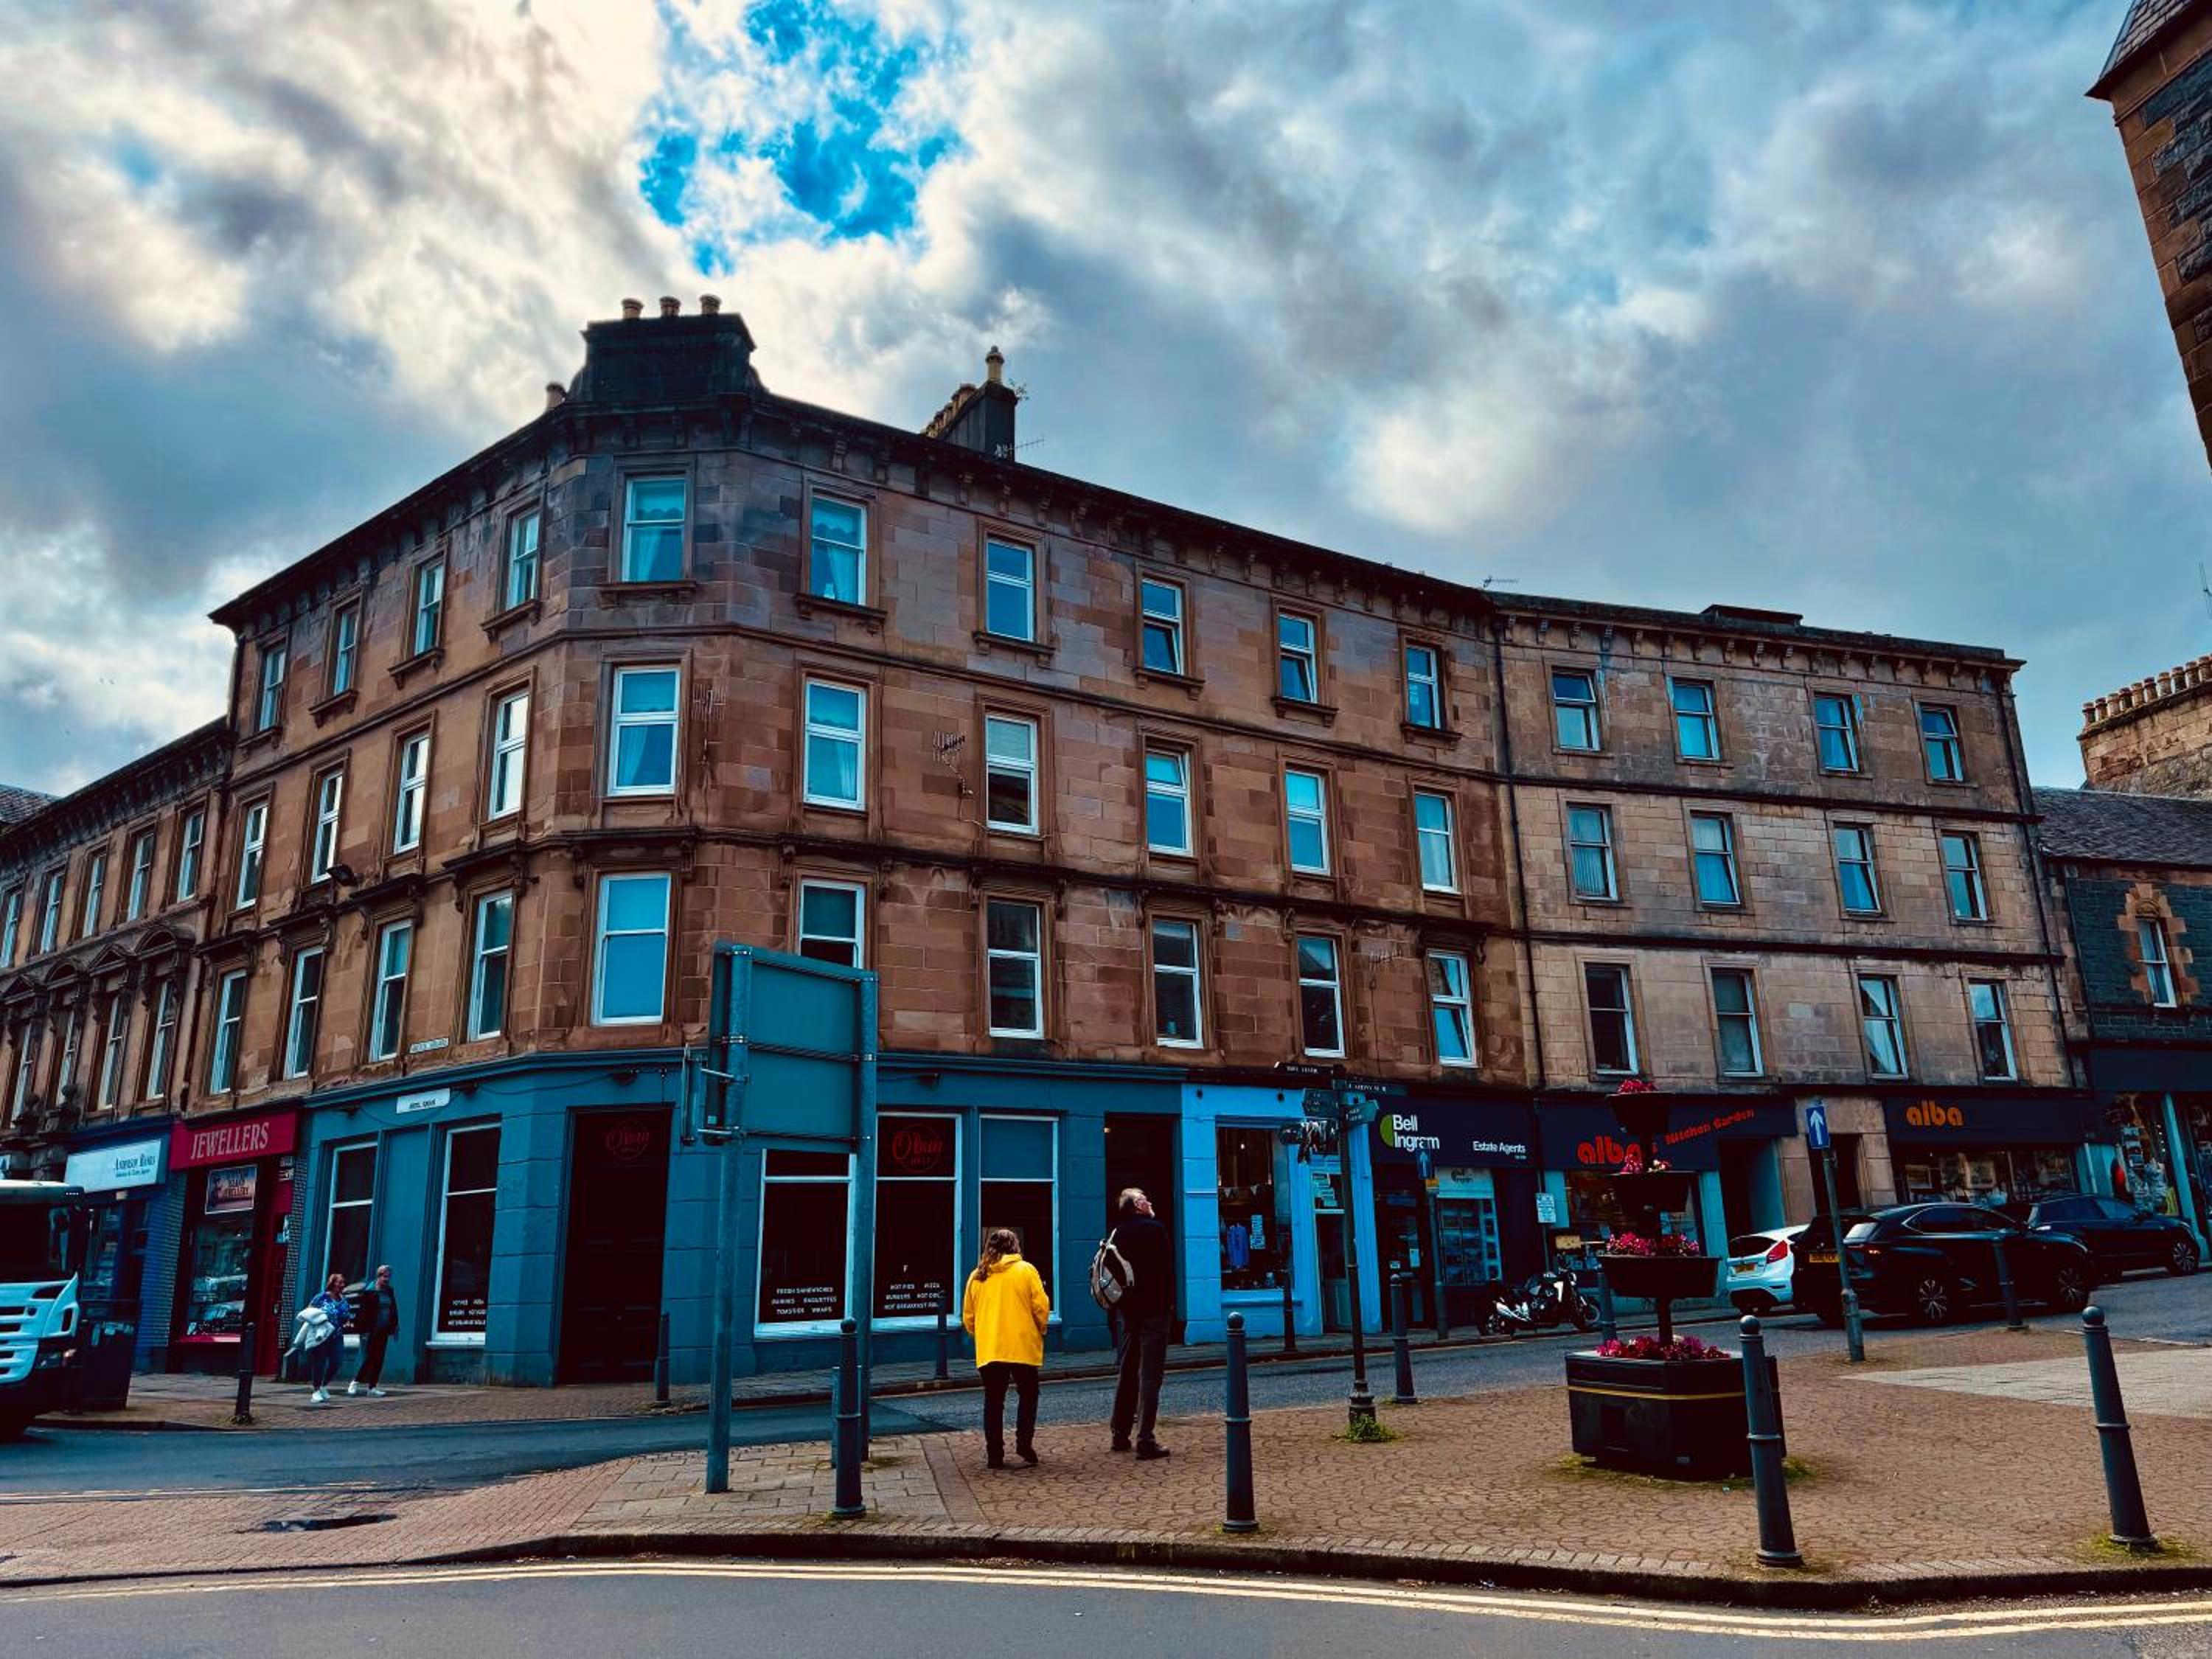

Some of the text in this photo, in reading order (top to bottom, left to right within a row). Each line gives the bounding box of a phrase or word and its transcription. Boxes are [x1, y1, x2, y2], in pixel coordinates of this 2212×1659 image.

[1393, 1114, 1418, 1131] Bell
[1906, 1099, 1964, 1127] alba
[189, 1121, 270, 1161] JEWELLERS
[1394, 1132, 1440, 1152] Ingram
[1473, 1141, 1526, 1155] Estate Agents
